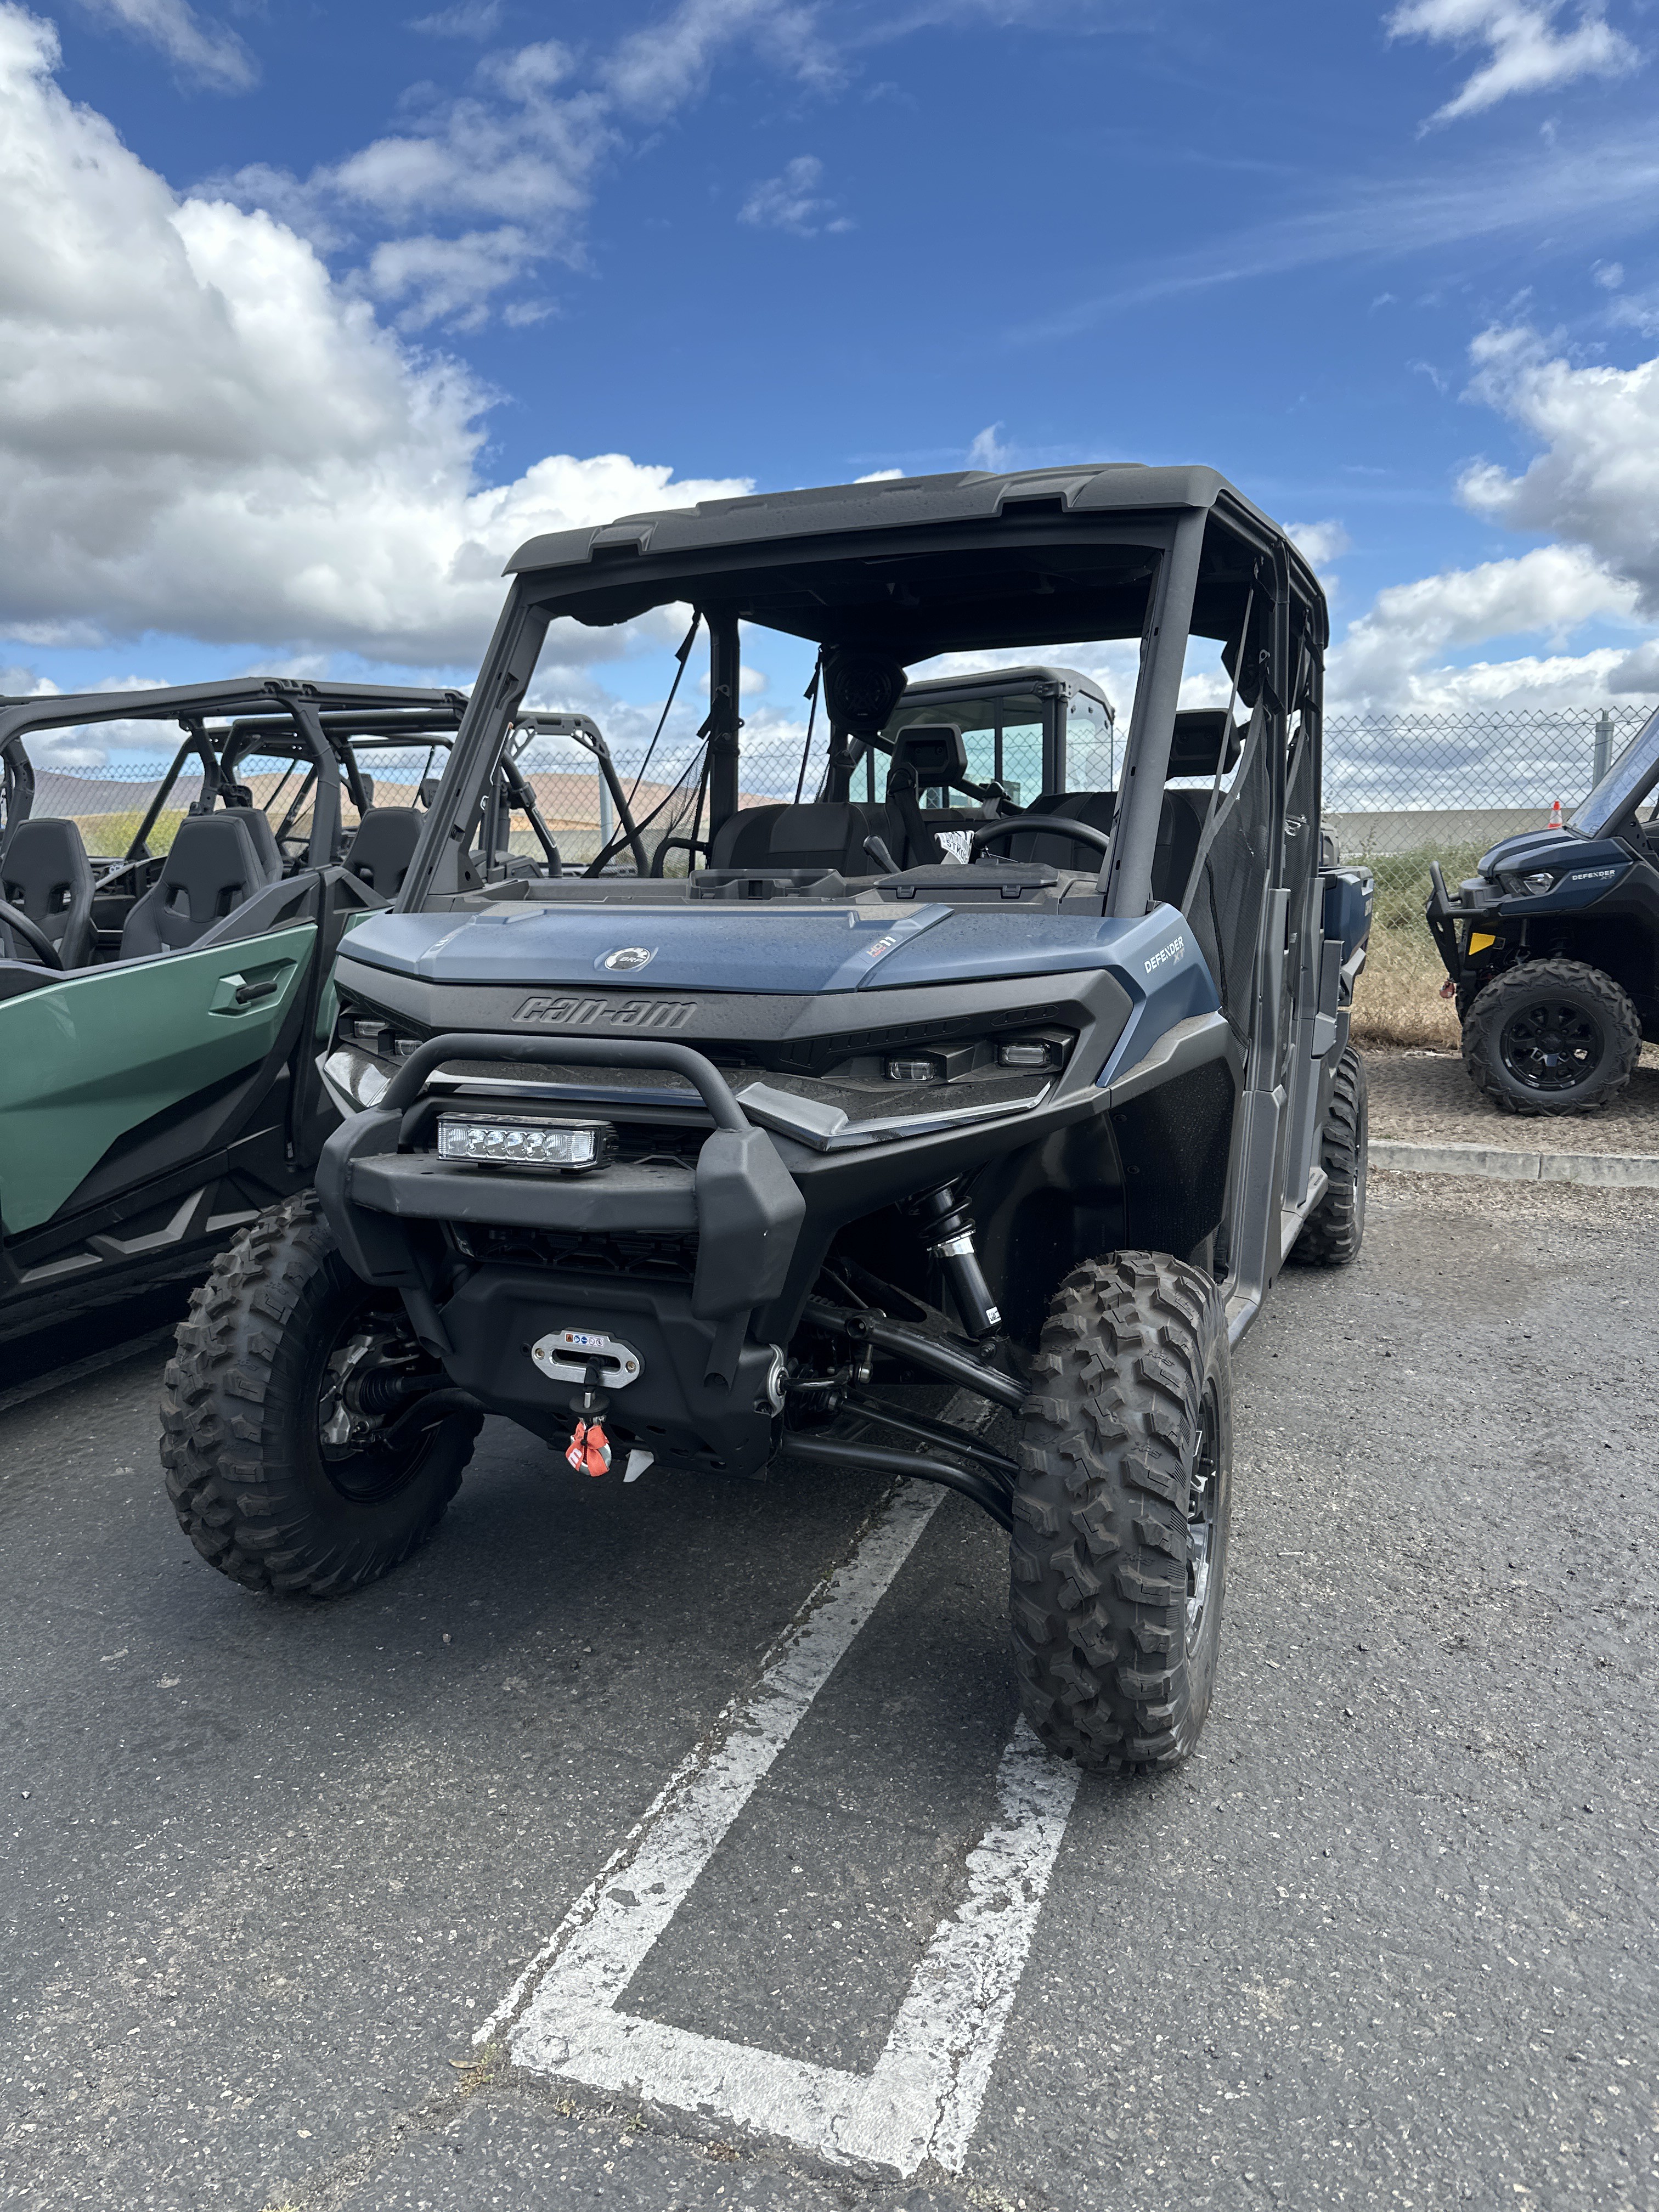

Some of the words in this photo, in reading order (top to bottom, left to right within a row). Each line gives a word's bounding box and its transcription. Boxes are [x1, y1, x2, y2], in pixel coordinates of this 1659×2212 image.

[1572, 870, 1615, 881] DEFENDER
[1144, 936, 1184, 973] DEFENDER
[1173, 947, 1184, 966] XT
